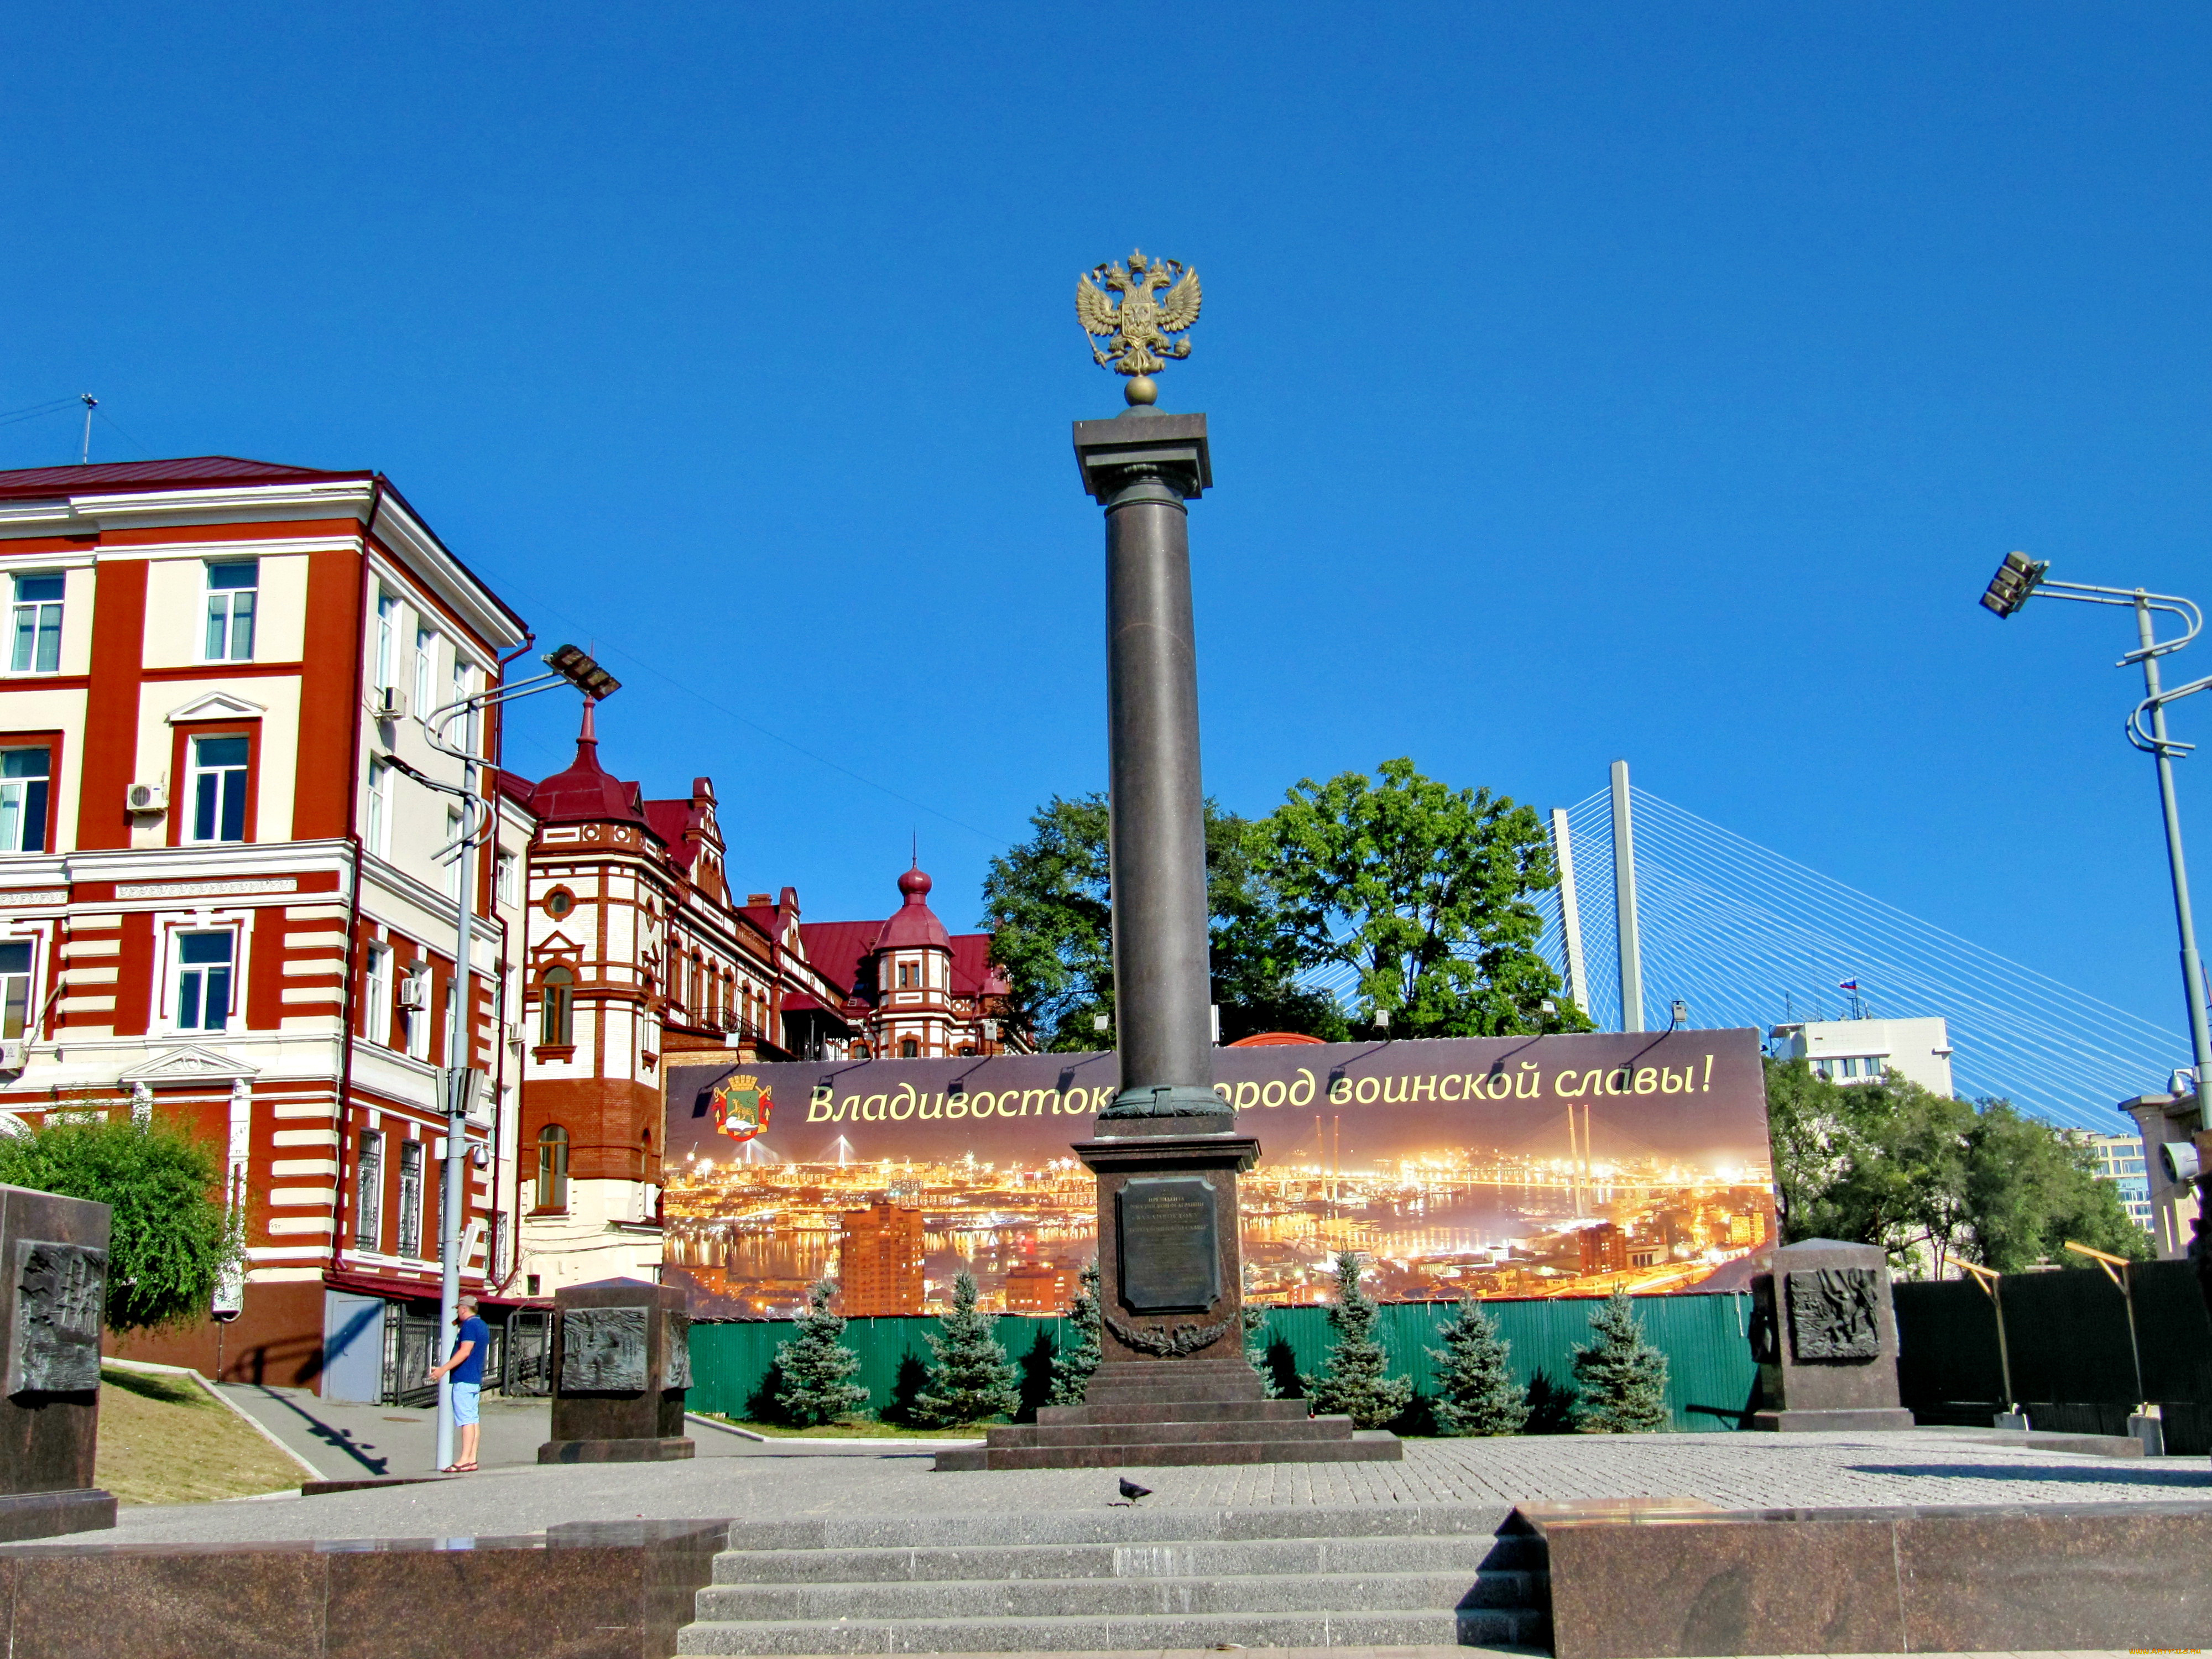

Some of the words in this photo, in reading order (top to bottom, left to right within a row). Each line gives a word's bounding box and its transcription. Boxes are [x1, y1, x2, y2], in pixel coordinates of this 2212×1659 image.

[805, 1082, 1116, 1123] Владивосток
[1213, 1068, 1316, 1112] ород
[1329, 1061, 1542, 1105] воинской
[1554, 1054, 1714, 1098] славы!
